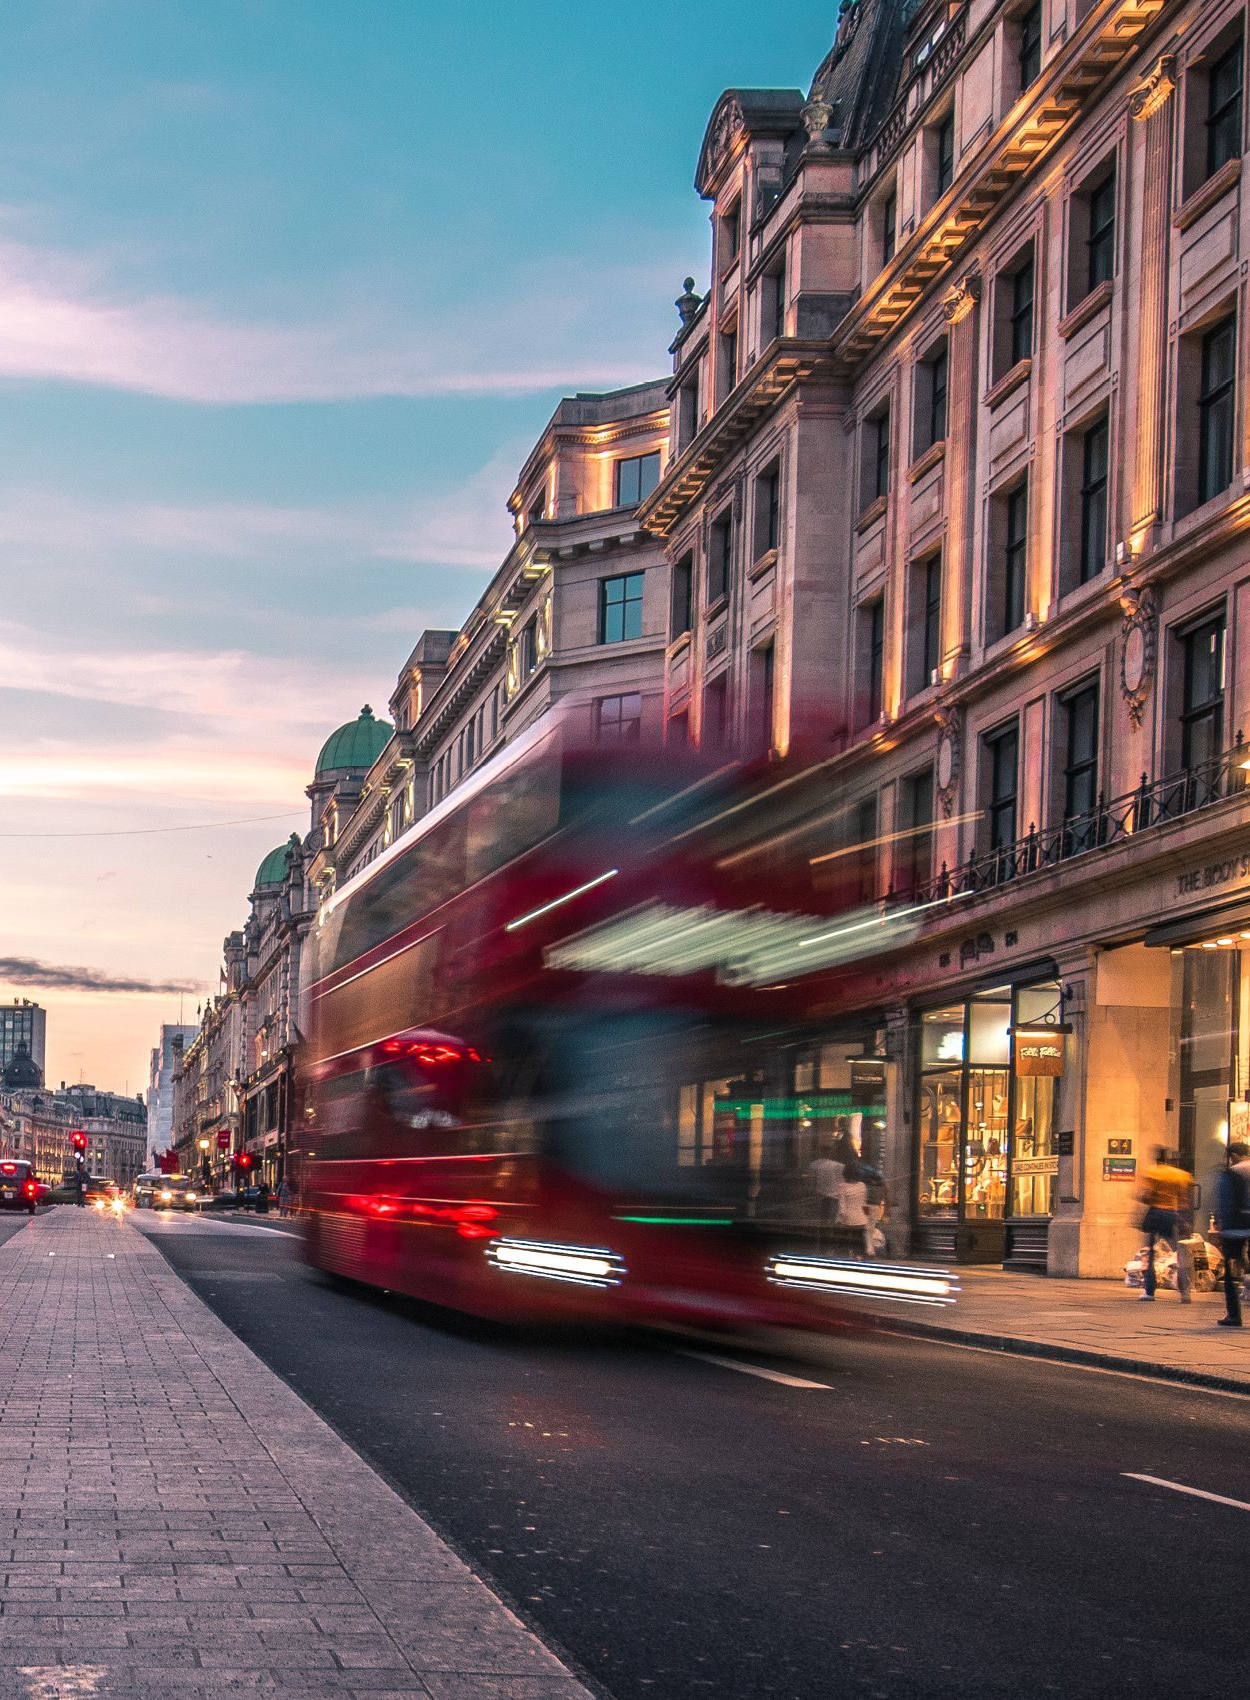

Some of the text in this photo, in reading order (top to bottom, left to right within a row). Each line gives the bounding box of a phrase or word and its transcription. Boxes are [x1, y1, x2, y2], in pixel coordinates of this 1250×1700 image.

[1178, 869, 1201, 896] THE
[1203, 858, 1239, 888] BODY
[1020, 1046, 1061, 1060] Folli Follie
